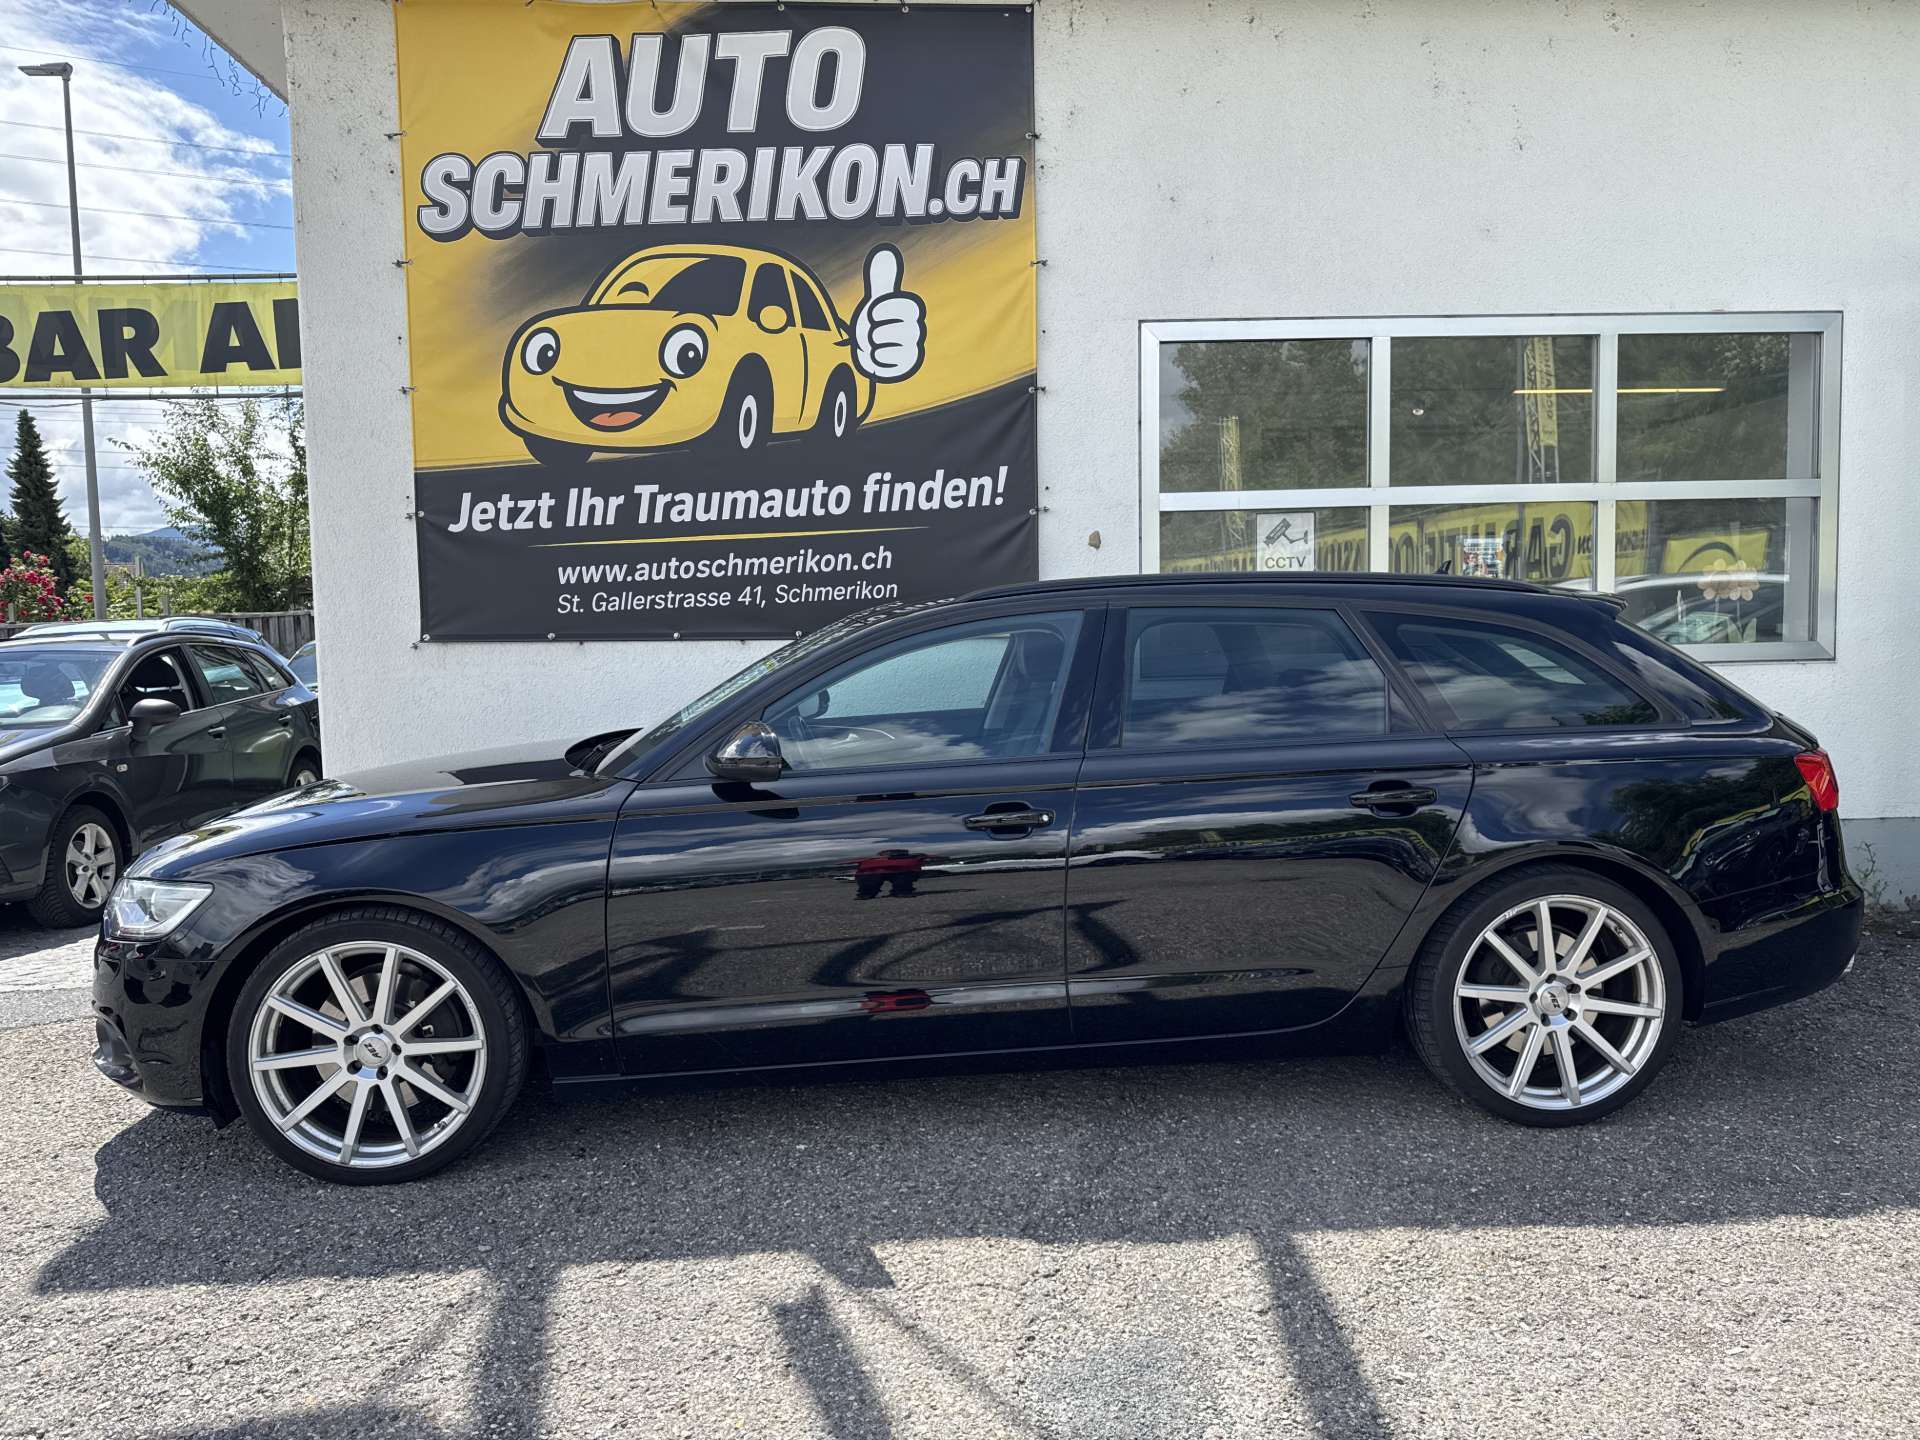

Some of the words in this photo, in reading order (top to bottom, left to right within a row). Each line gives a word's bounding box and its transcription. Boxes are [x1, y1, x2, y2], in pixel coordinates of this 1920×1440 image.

[537, 26, 866, 140] AUTO
[418, 142, 1022, 234] SCHMERIKON.CH
[448, 491, 553, 533] Jetzt
[566, 486, 623, 528] Ihr
[633, 478, 851, 525] Traumauto
[862, 466, 1009, 514] finden!
[557, 546, 893, 586] www.autoschmerikon.ch
[1264, 555, 1307, 570] CCTV
[557, 593, 585, 615] St.
[591, 586, 731, 613] Gallerstrasse
[737, 586, 766, 609] 41,
[775, 580, 898, 604] Schmerikon
